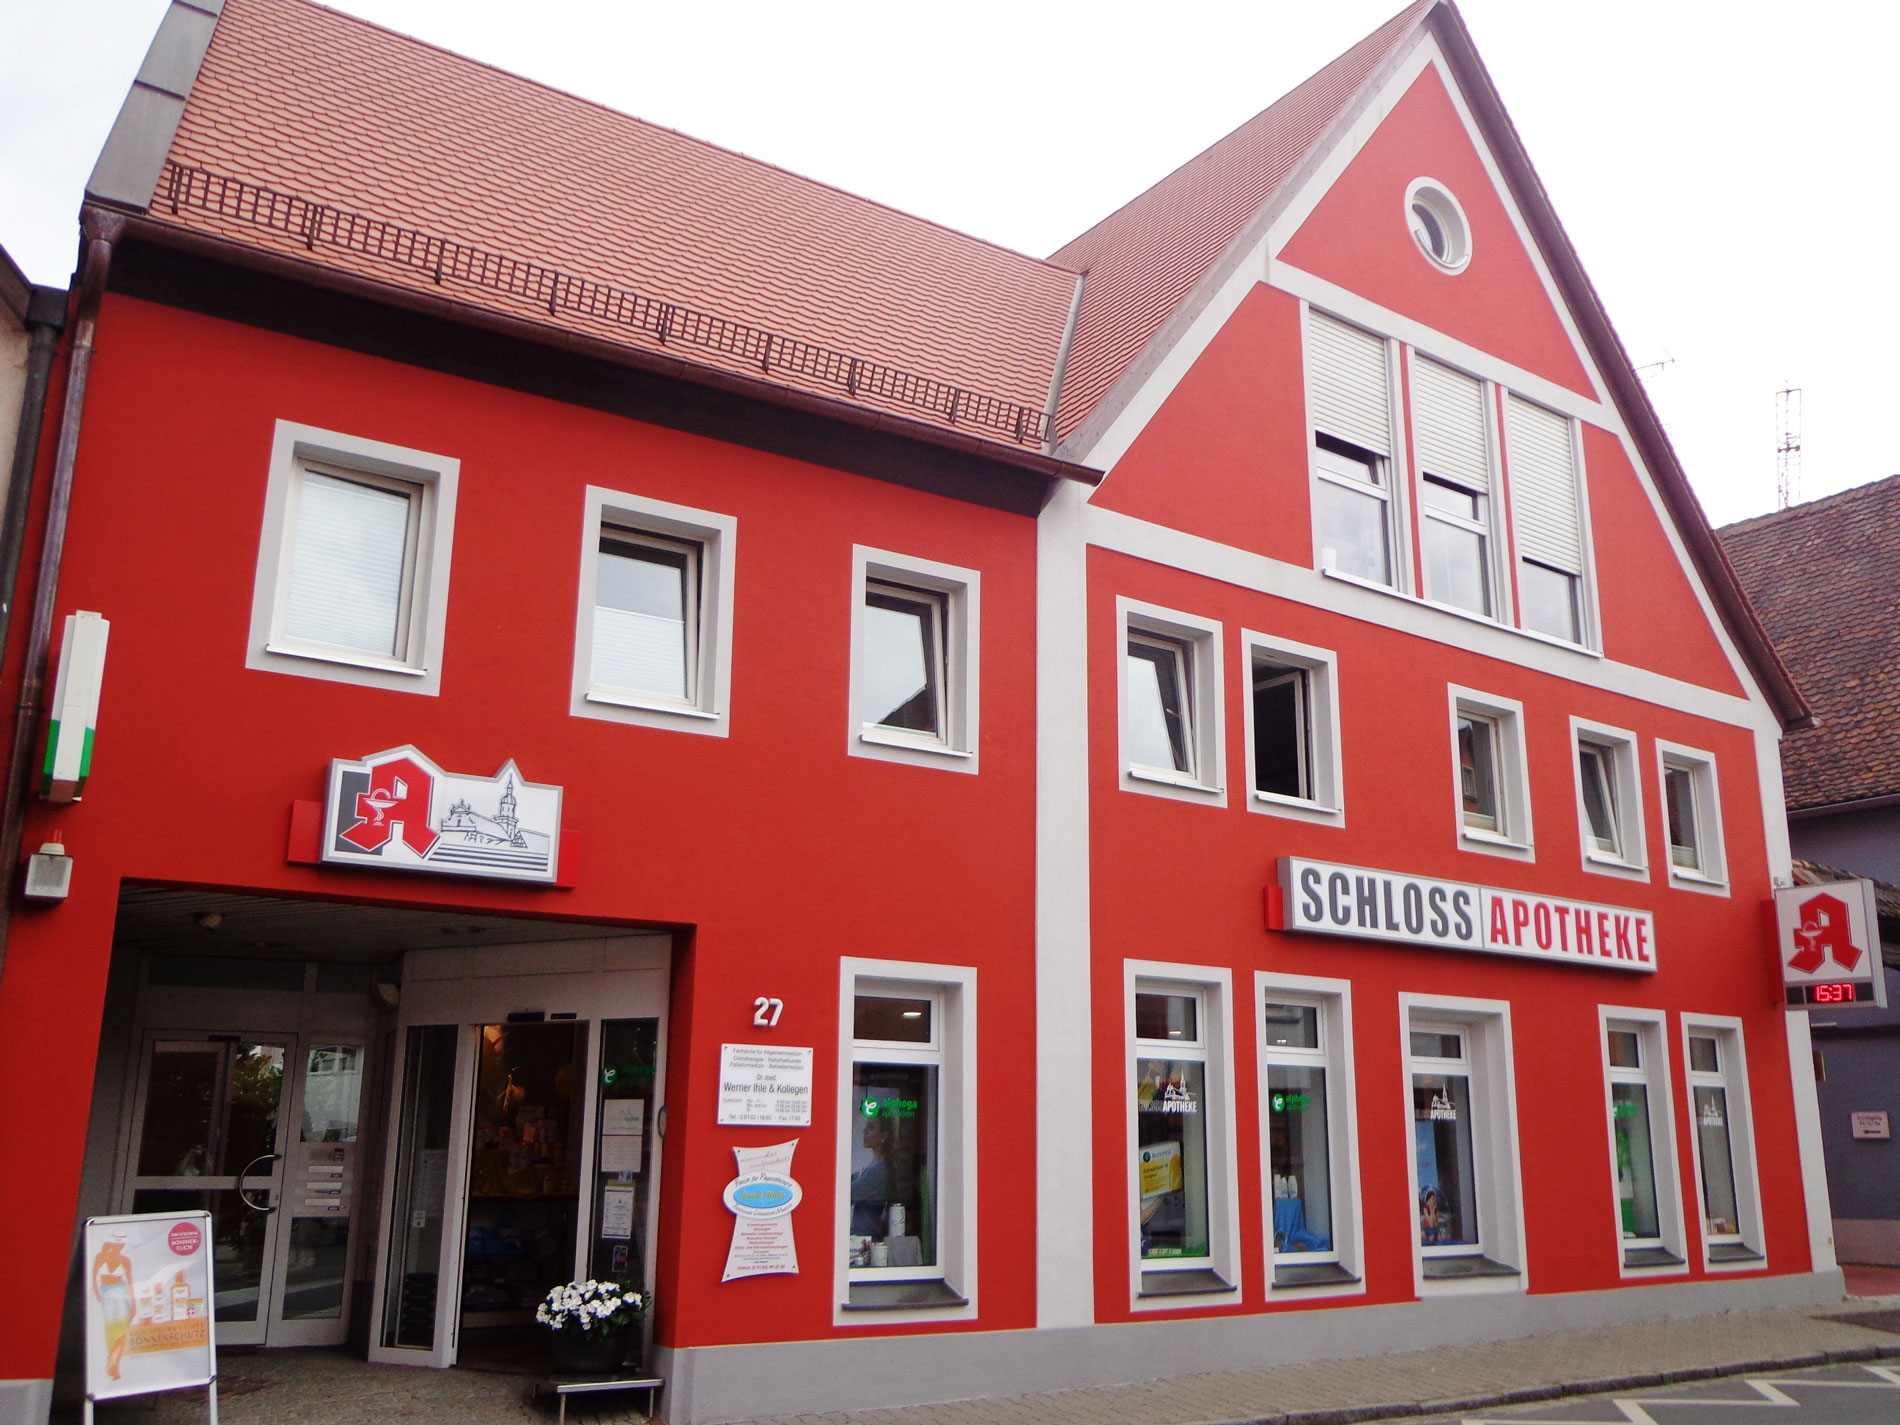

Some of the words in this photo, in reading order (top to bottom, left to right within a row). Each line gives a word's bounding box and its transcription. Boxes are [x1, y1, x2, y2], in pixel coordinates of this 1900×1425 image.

[1300, 867, 1473, 941] SCHLOSS
[1490, 895, 1650, 962] APOTHEKE
[1815, 983, 1853, 1002] 15:37
[753, 996, 784, 1026] 27
[723, 1082, 752, 1092] Werner
[753, 1083, 767, 1093] Ihle
[769, 1084, 775, 1093] &
[777, 1084, 808, 1095] Kollegen
[1163, 1100, 1198, 1112] APOTHEKE
[1430, 1109, 1457, 1120] APOTHEKE
[130, 1329, 206, 1346] SONNENSCHUTZ
